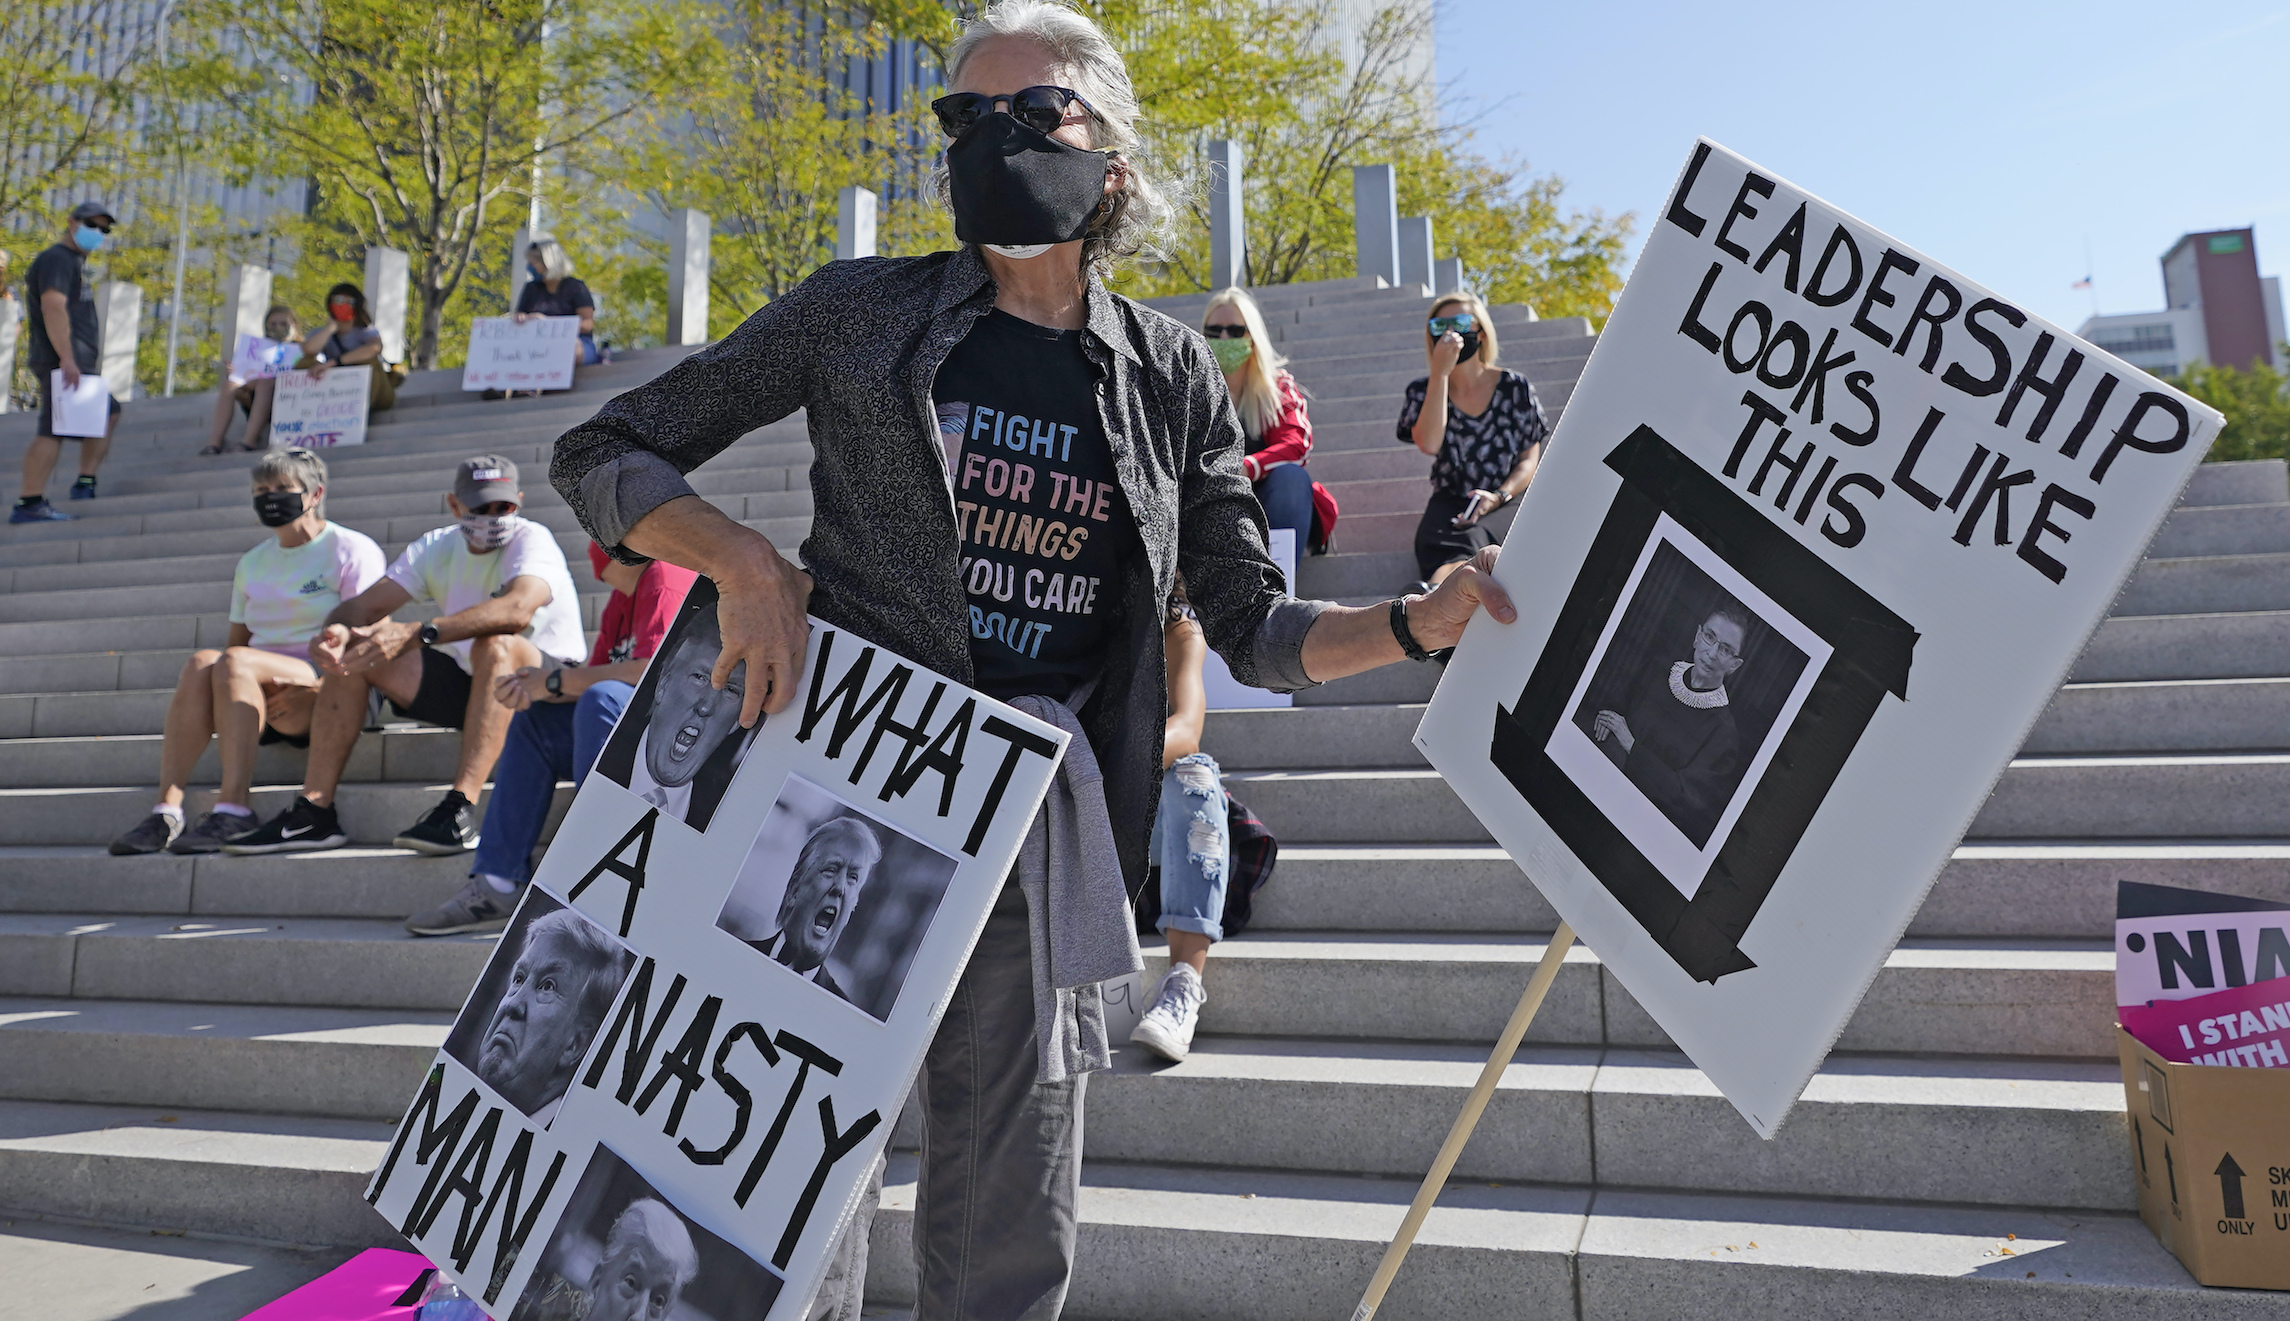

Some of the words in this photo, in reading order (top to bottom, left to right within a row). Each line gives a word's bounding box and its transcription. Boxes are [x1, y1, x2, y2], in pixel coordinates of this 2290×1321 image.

[1666, 143, 2189, 484] LEADERSHIP
[285, 432, 344, 448] VOTE
[971, 405, 1079, 462] FIGHT
[1678, 262, 1880, 446] LOOKS
[1892, 406, 2096, 585] LIKE
[961, 452, 1035, 504] FOR
[1049, 471, 1114, 522] THE
[1722, 391, 1885, 548] THIS
[957, 500, 1089, 561] THINGS
[1025, 568, 1101, 615] CARE
[969, 603, 1053, 660] BOUT
[795, 630, 1059, 857] WHAT
[568, 808, 658, 938] A
[2178, 1024, 2196, 1050] I
[2198, 1001, 2290, 1046] STAN
[583, 957, 881, 1272] NASTY
[368, 1063, 567, 1306] MAN
[2268, 1166, 2290, 1186] SK
[2217, 1221, 2255, 1236] ONLY
